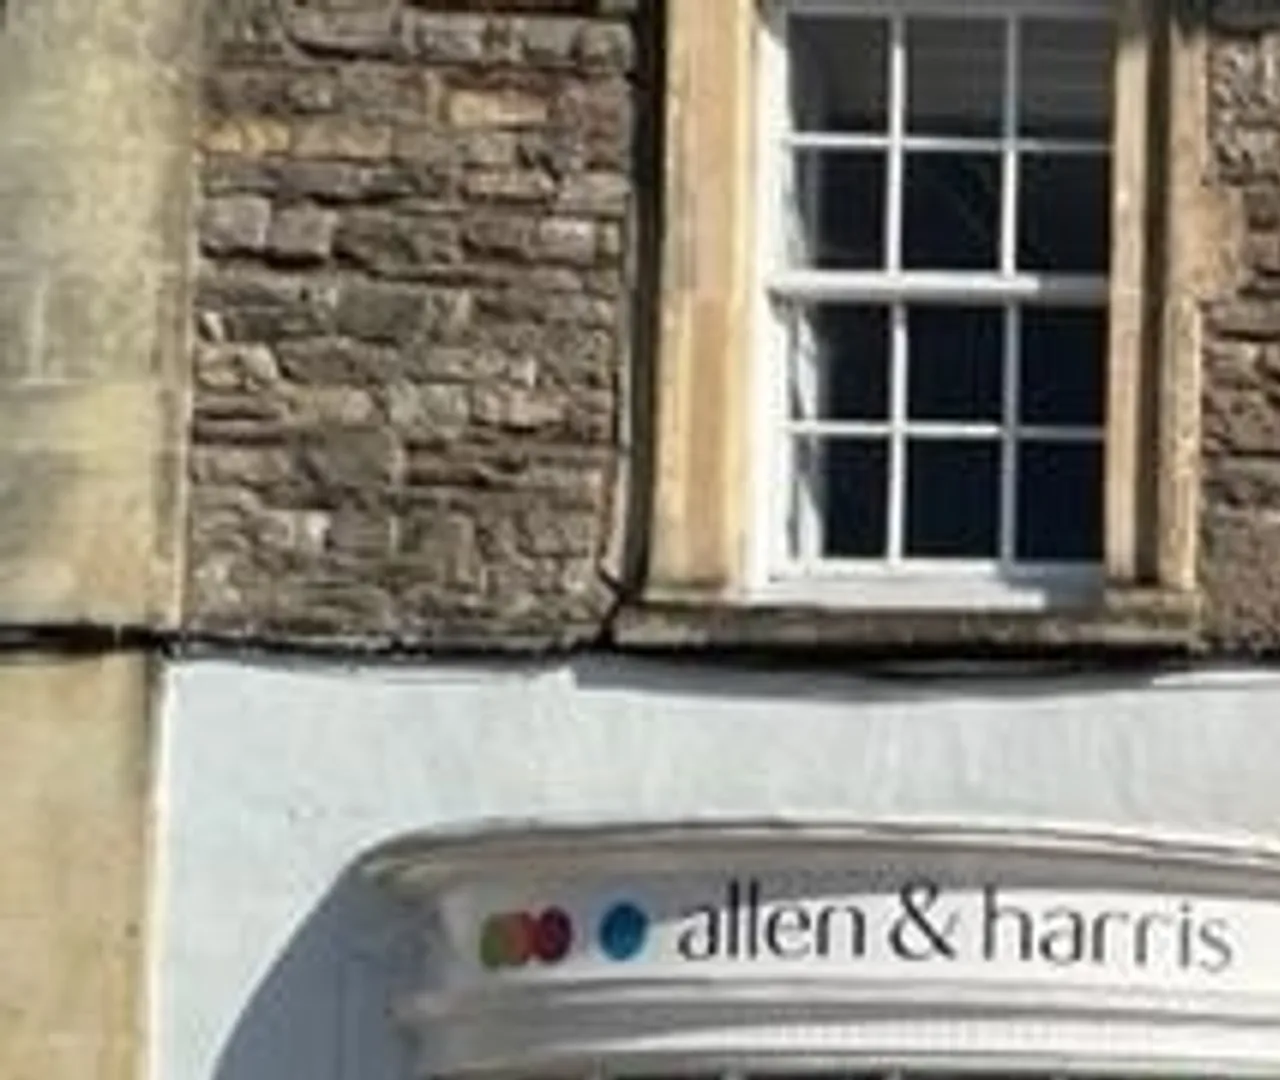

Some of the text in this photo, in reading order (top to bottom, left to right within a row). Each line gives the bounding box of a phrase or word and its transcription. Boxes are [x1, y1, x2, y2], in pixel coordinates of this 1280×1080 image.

[676, 880, 1234, 973] allen & harris
